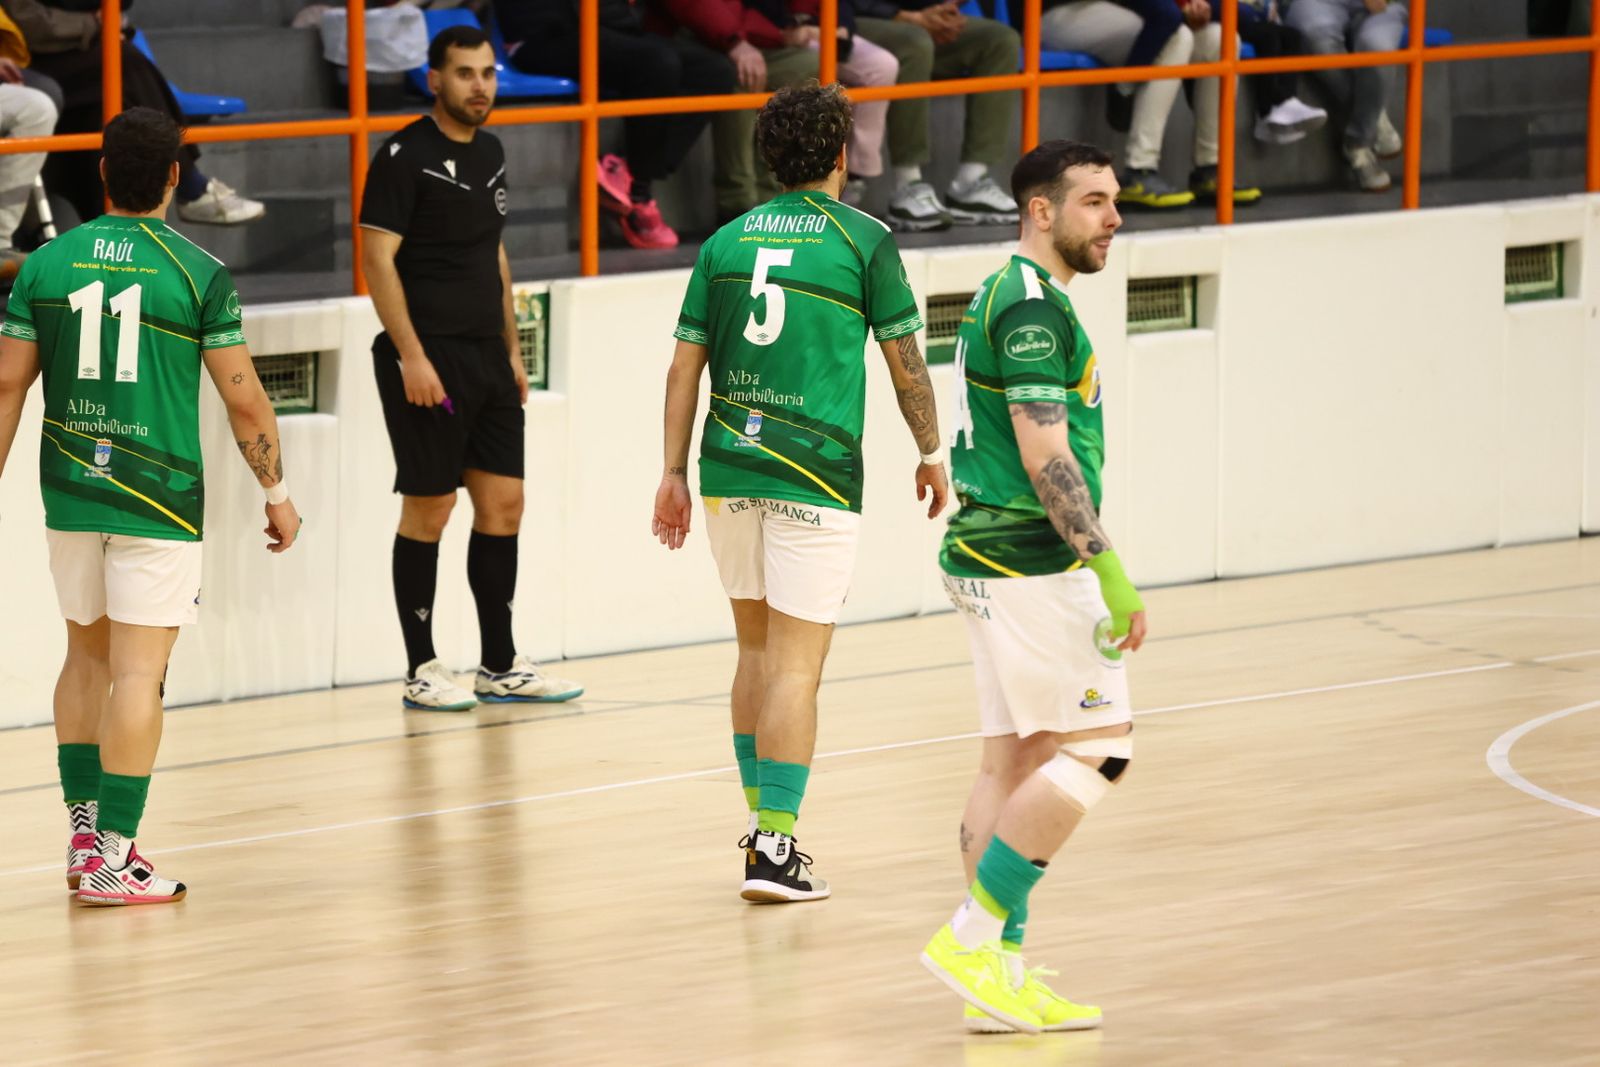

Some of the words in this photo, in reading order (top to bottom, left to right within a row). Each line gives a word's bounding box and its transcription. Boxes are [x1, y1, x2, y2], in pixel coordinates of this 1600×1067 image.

[743, 213, 828, 233] CAMINERO
[93, 237, 134, 262] RAÚL
[743, 247, 795, 346] 5
[67, 280, 142, 383] 11
[728, 370, 760, 385] Alba
[67, 399, 106, 416] Alba
[65, 418, 148, 437] inmobiliaria
[728, 500, 749, 514] DE
